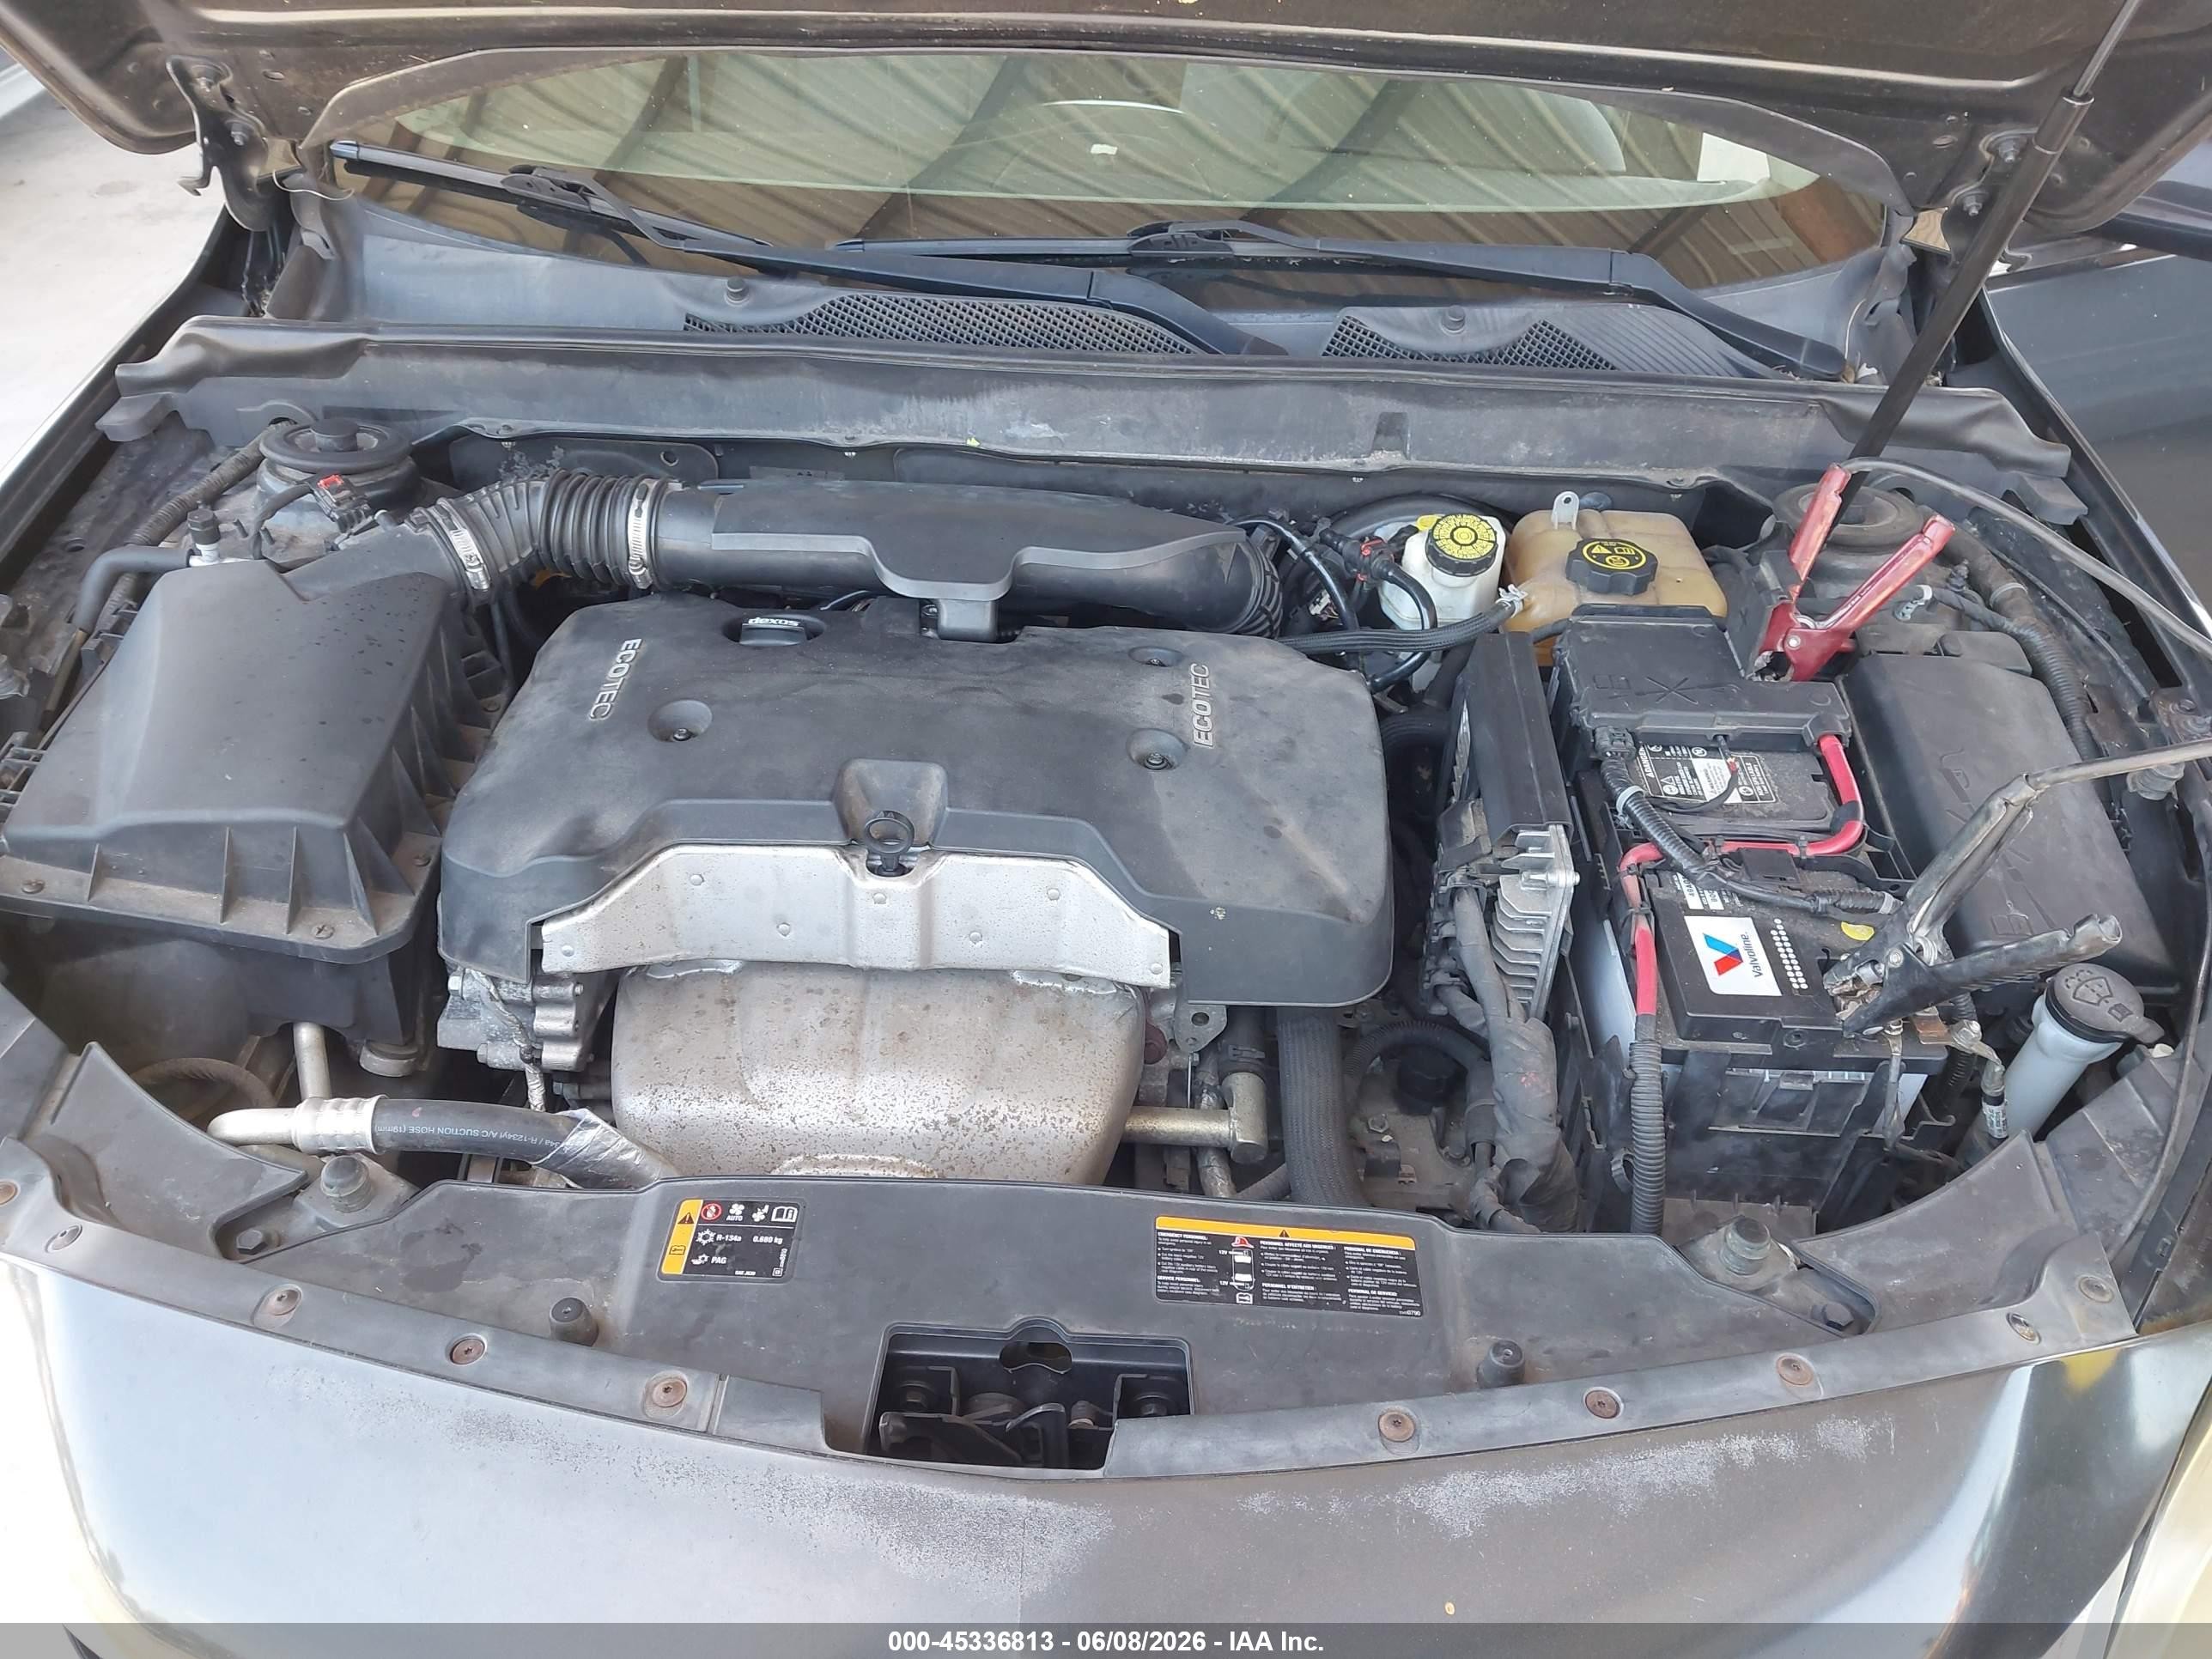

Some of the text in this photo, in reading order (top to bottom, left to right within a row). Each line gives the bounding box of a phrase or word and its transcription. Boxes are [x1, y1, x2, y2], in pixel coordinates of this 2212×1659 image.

[748, 617, 800, 626] dexos
[590, 638, 642, 719] ECOTEC
[1190, 663, 1213, 747] ECOTEC
[1741, 933, 1763, 978] Valvoline
[374, 1124, 405, 1133] (19mm)
[437, 1127, 479, 1137] SUCTION
[481, 1128, 498, 1139] A/C
[499, 1131, 538, 1145] R-1234yf
